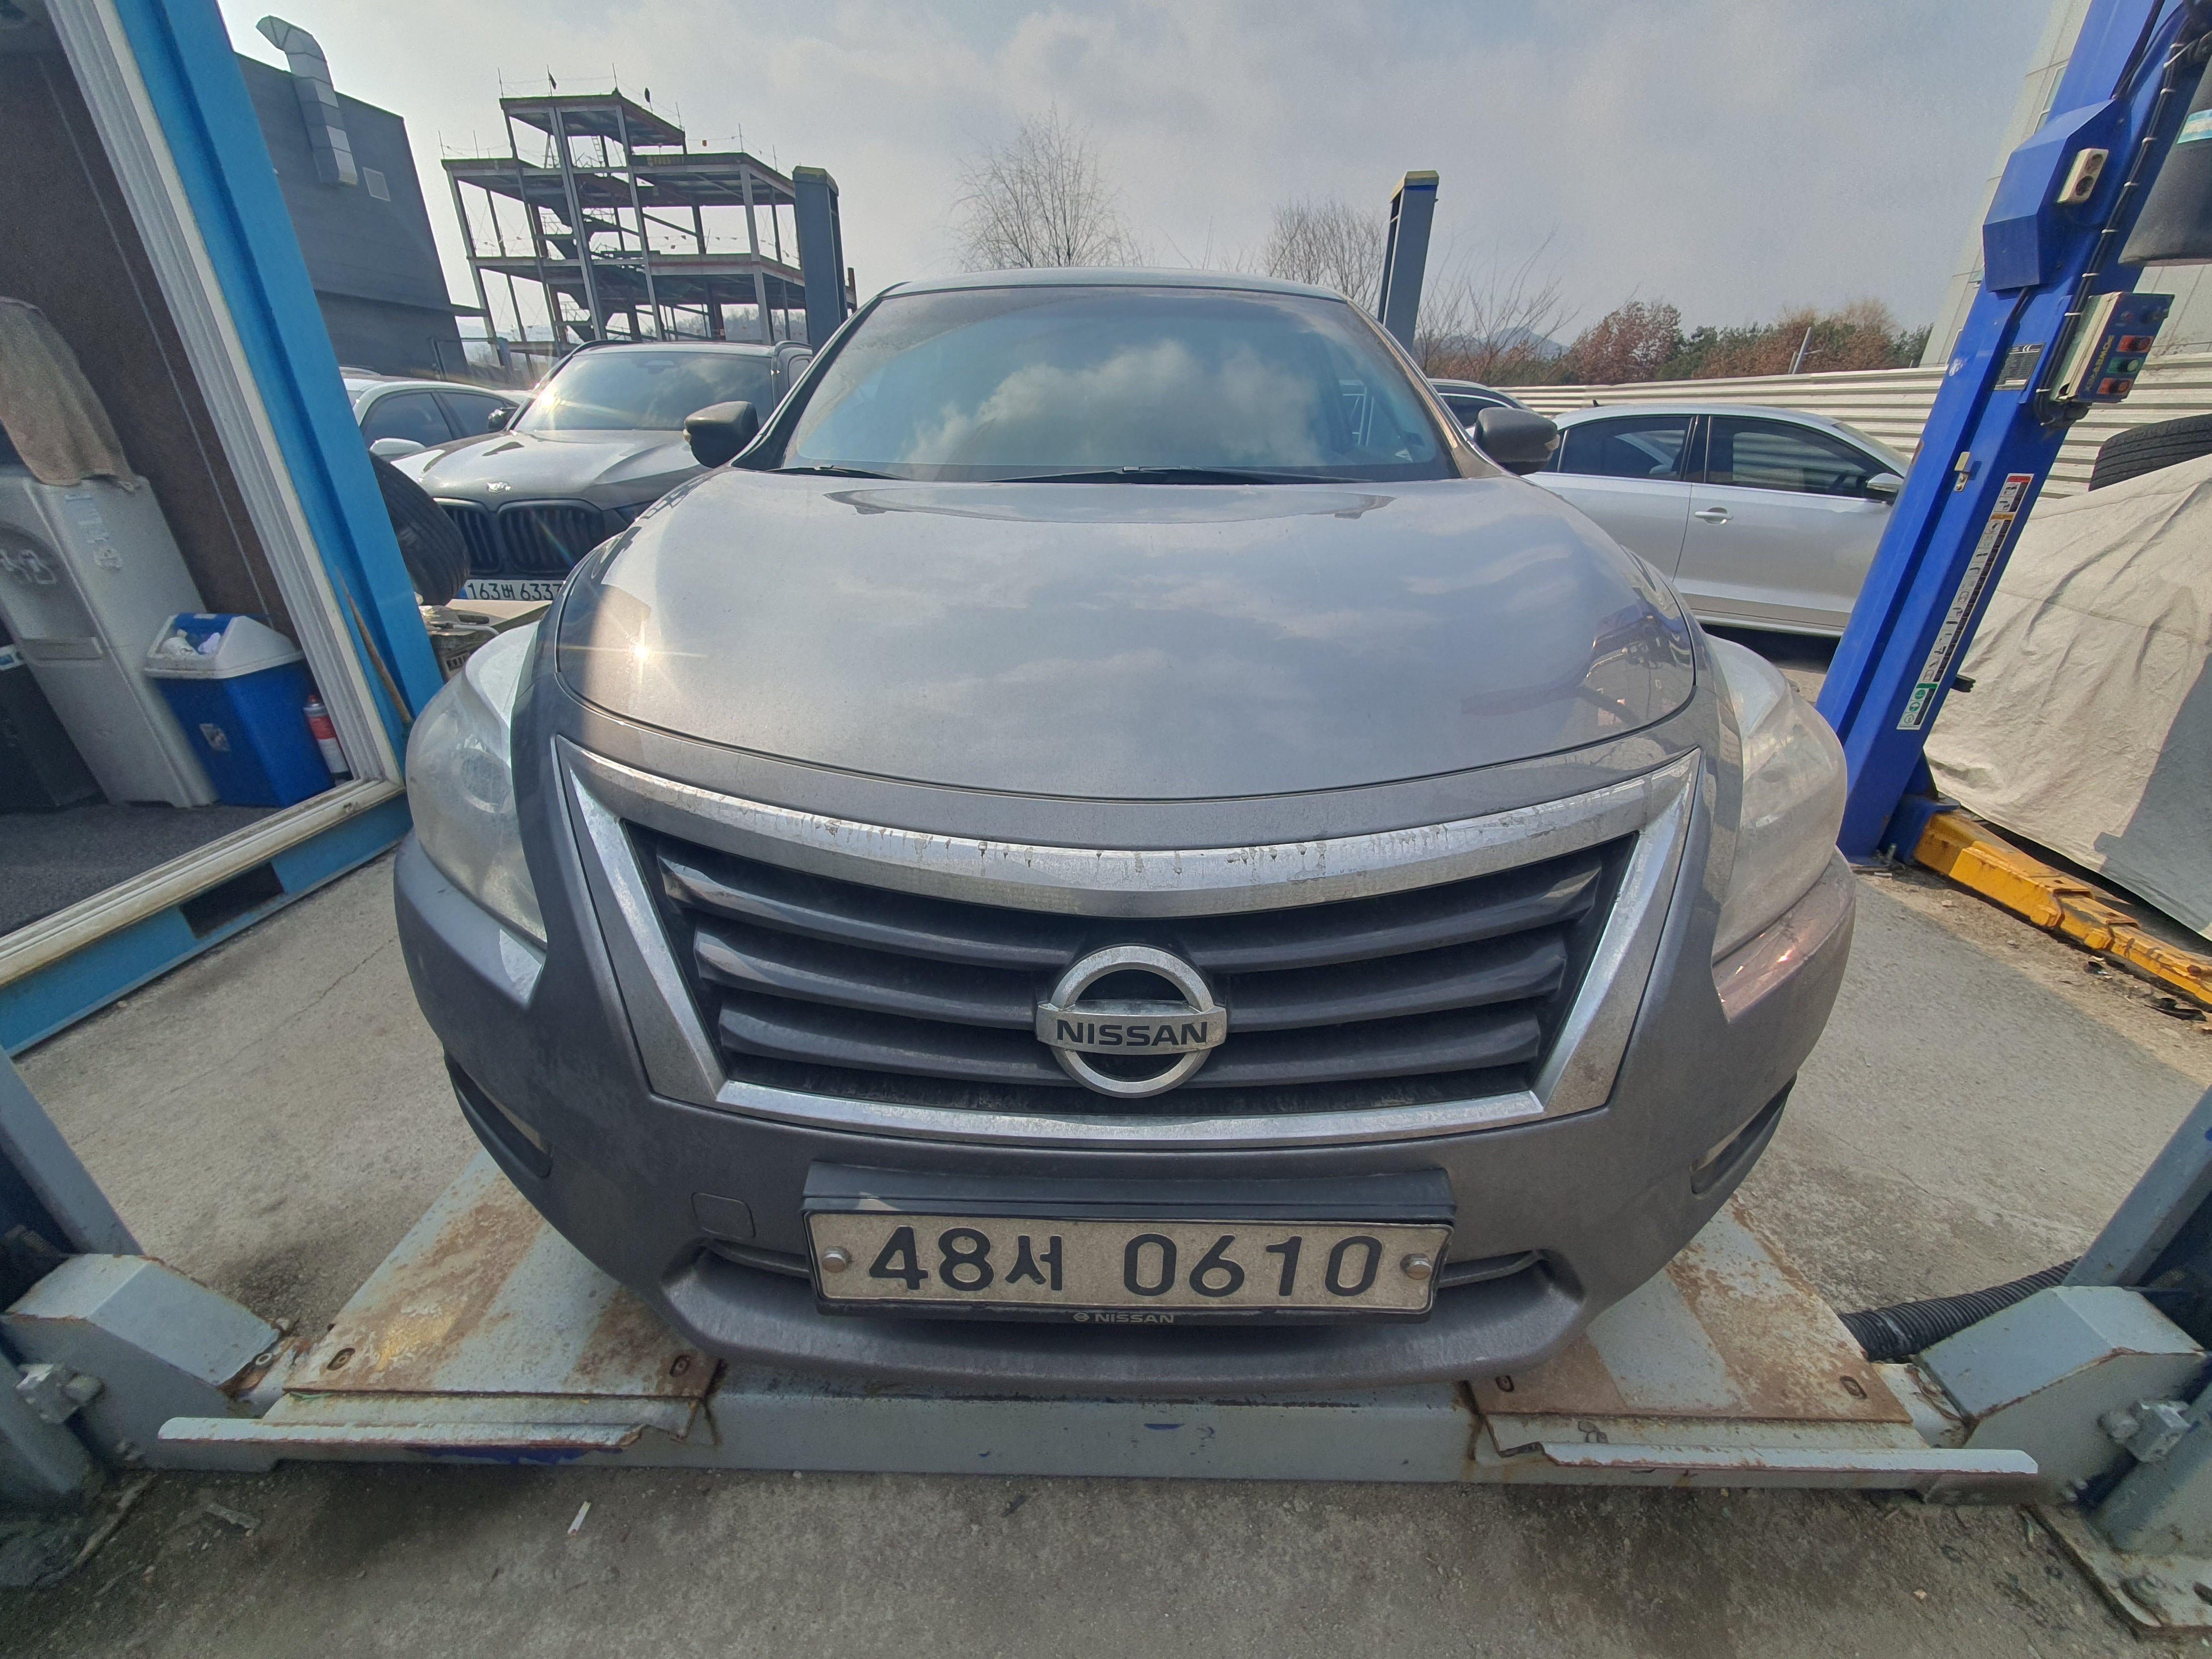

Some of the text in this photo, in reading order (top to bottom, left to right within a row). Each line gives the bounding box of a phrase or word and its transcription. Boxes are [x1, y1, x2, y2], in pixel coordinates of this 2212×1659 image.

[468, 583, 516, 600] 163버
[1057, 1019, 1208, 1046] NISSAN
[869, 1226, 1382, 1297] 48서 0610
[1095, 1313, 1174, 1323] NISSAN
